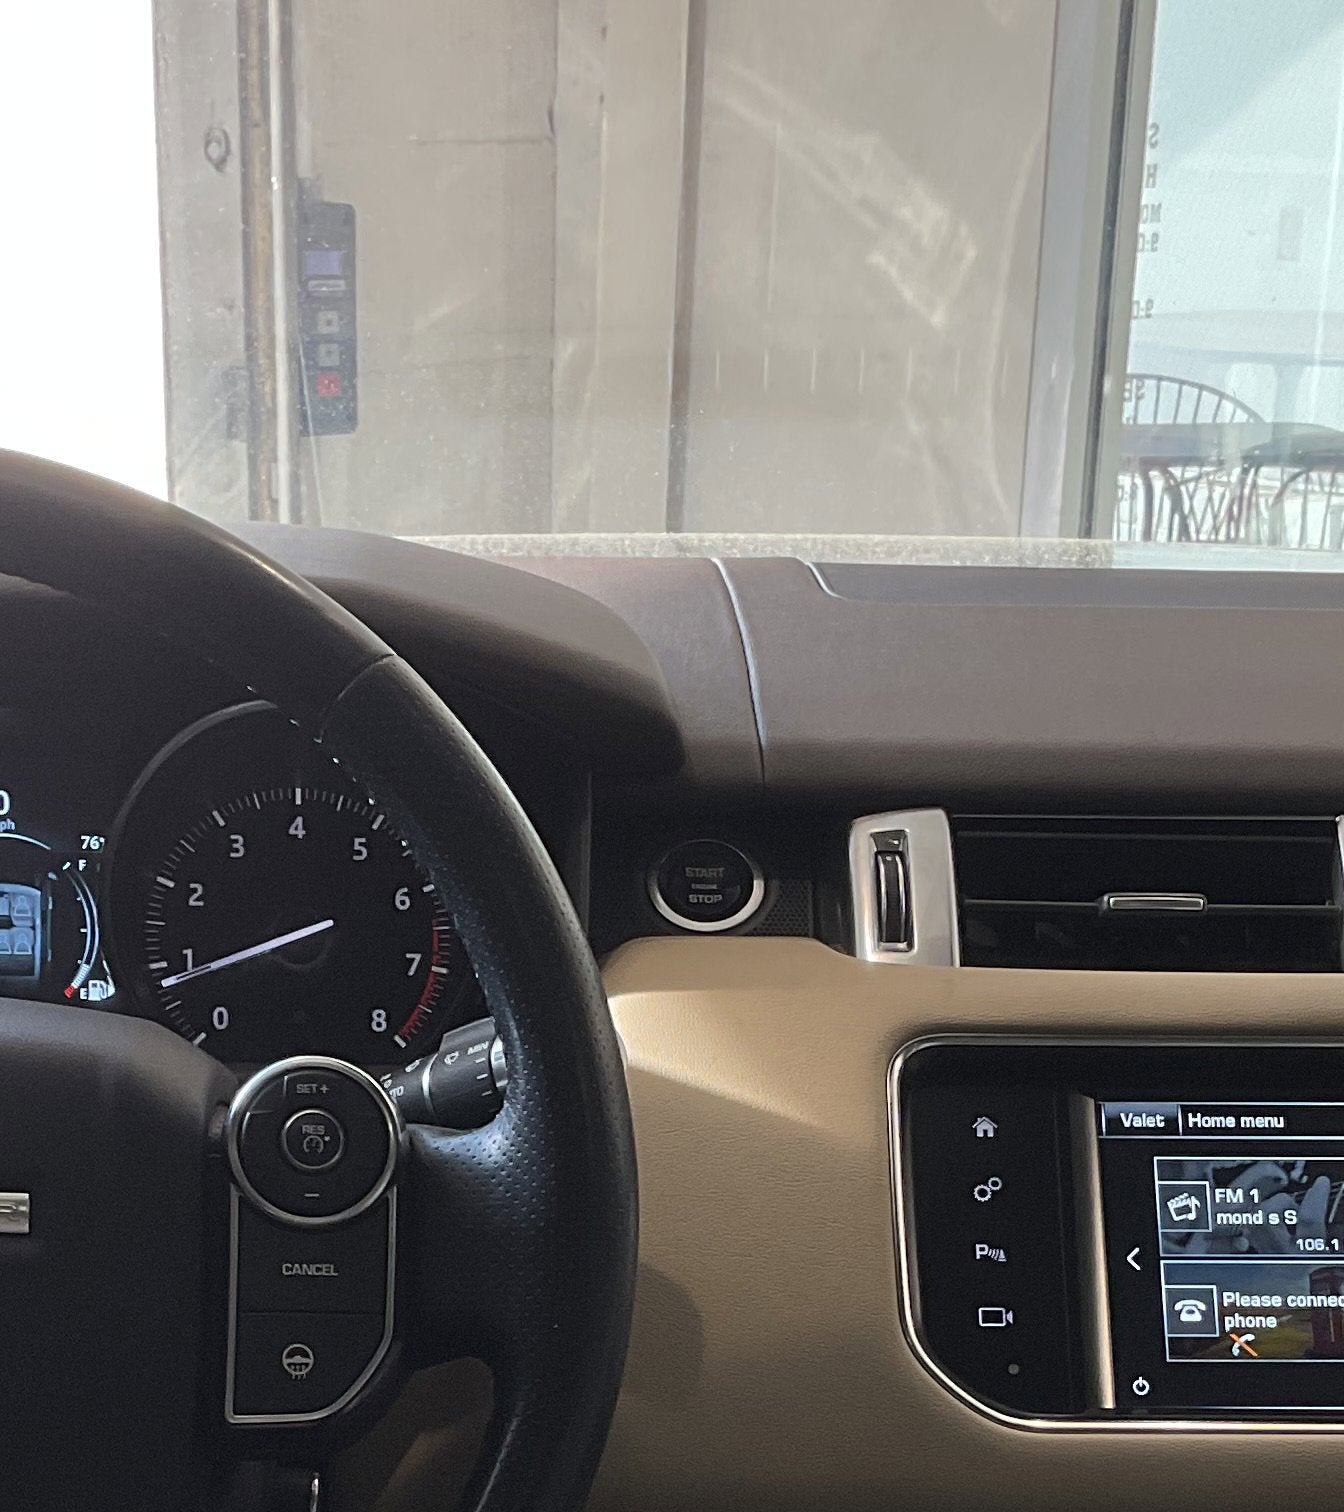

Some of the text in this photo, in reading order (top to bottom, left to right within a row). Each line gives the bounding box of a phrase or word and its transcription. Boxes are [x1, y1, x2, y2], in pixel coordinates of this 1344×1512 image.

[289, 816, 306, 839] 4
[229, 835, 245, 858] 3
[352, 839, 367, 861] 5
[78, 859, 87, 871] F
[684, 867, 725, 877] START
[188, 884, 204, 906] 2
[394, 888, 410, 910] 6
[688, 894, 723, 904] STOP
[182, 949, 194, 970] 1
[405, 954, 422, 976] 7
[79, 987, 88, 999] E
[212, 1006, 229, 1029] 0
[371, 1009, 387, 1031] 8
[296, 1084, 317, 1094] SET
[1119, 1112, 1165, 1129] Valet
[1188, 1112, 1285, 1129] Home menu
[302, 1125, 326, 1135] RES
[1214, 1188, 1260, 1204] FM 1
[1216, 1210, 1298, 1225] mond s S
[1296, 1238, 1339, 1251] 106.1
[281, 1263, 339, 1276] CANCEL
[1222, 1292, 1282, 1307] Please
[1224, 1313, 1278, 1332] phone
